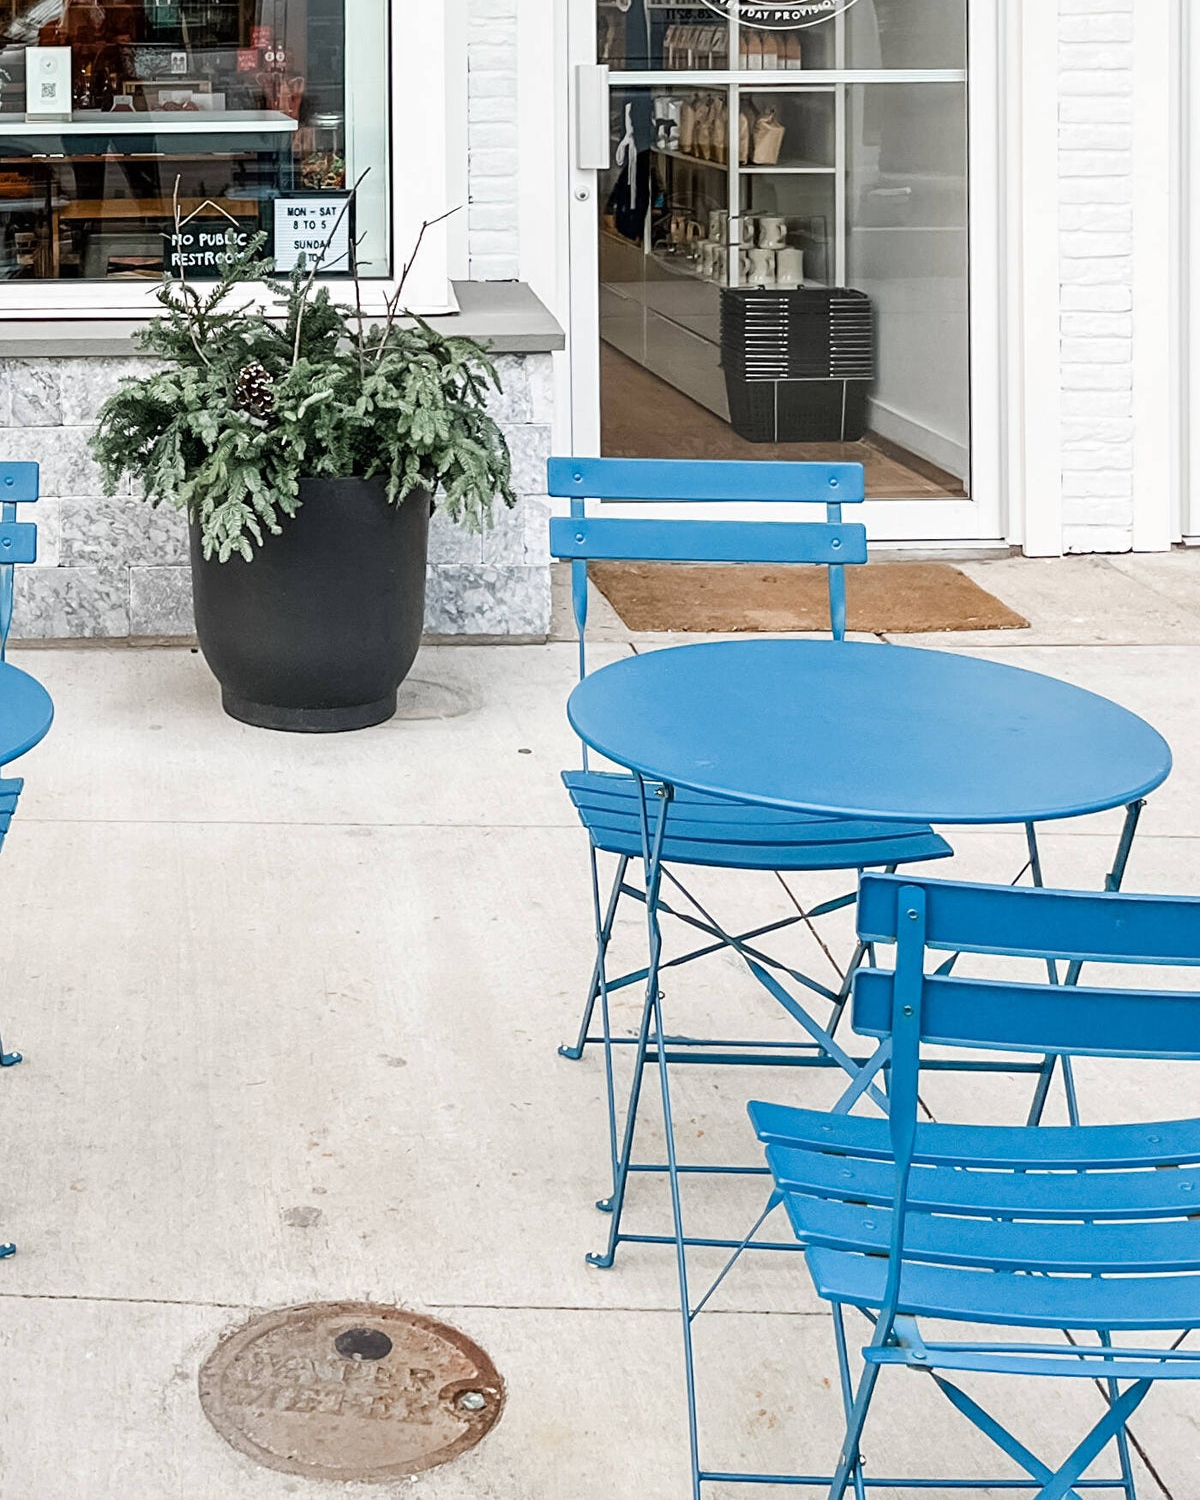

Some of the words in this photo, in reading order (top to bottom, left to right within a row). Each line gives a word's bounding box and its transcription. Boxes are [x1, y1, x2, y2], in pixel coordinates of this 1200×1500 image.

[287, 207, 306, 217] MON
[319, 207, 337, 216] SAT
[293, 220, 299, 229] 8
[304, 220, 316, 229] TO
[321, 220, 327, 229] 5
[171, 233, 194, 246] NO
[199, 233, 247, 247] PUBLIC
